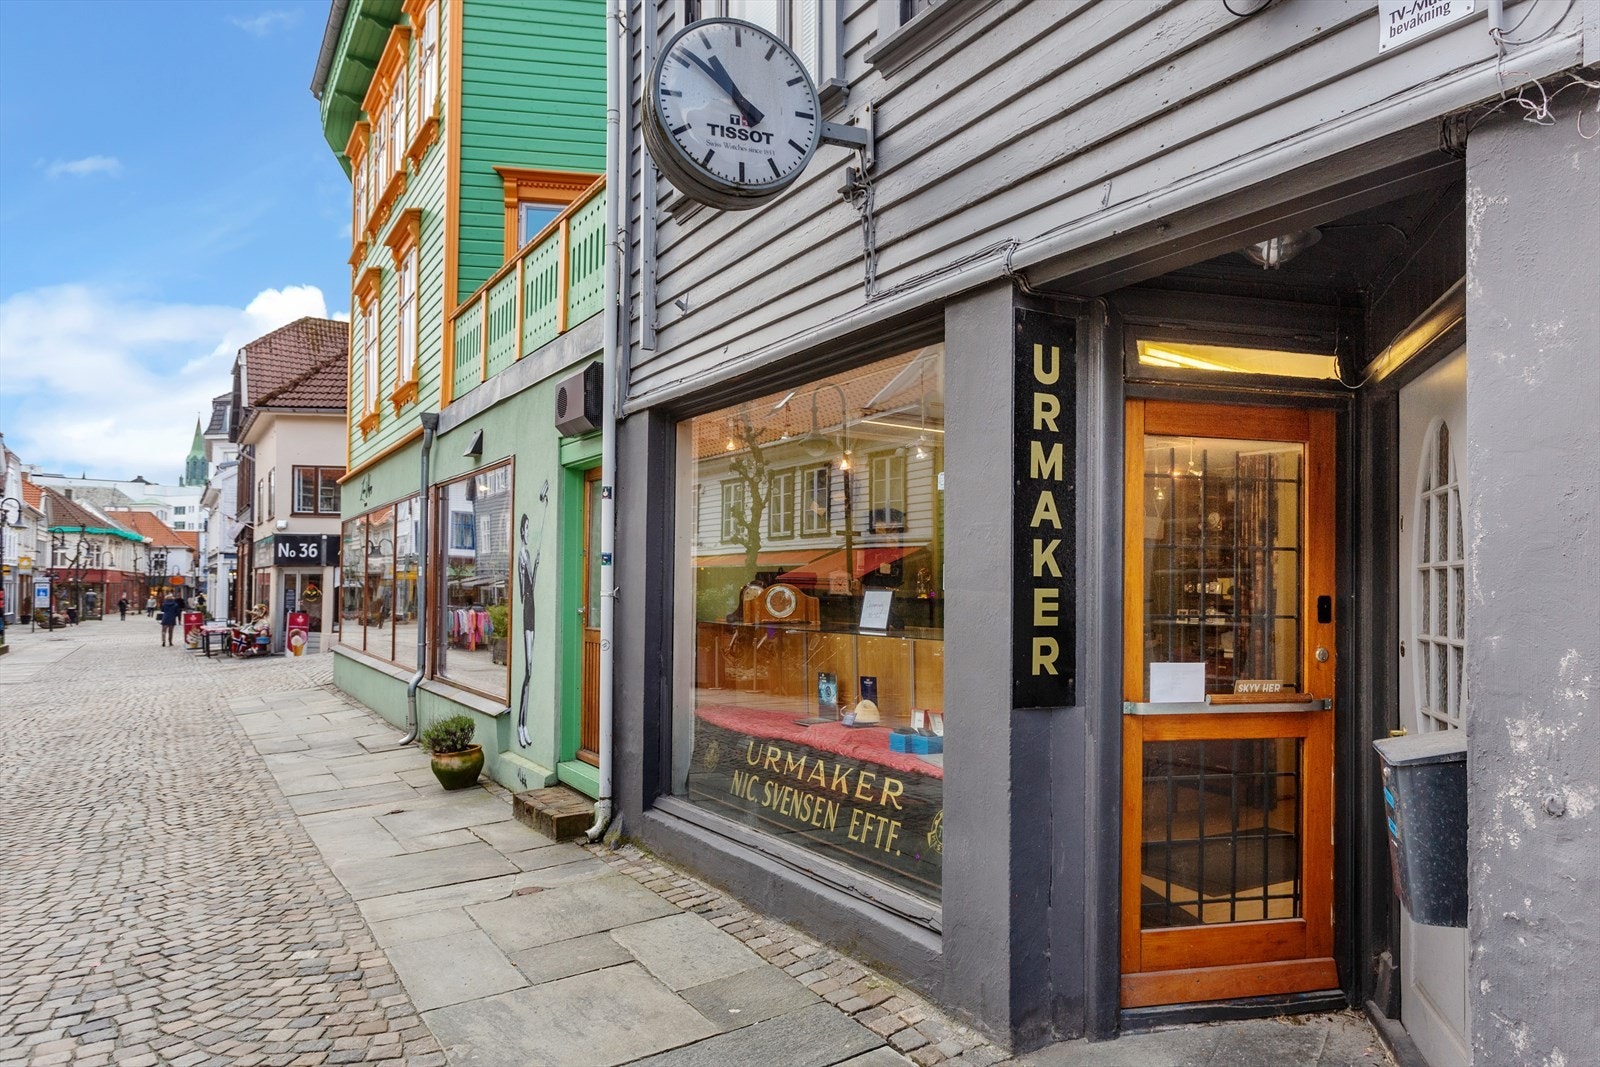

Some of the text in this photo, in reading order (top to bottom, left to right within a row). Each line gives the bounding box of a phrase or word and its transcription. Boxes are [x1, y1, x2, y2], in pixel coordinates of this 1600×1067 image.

[1389, 2, 1451, 38] bevakning
[706, 140, 722, 148] Swiss
[723, 141, 747, 152] Watches
[749, 146, 763, 154] since
[707, 123, 774, 145] TISSOT
[1030, 343, 1063, 676] URMAKER
[278, 543, 318, 558] No 36
[1238, 683, 1281, 693] SKYV HER
[746, 740, 904, 811] URMAKER
[730, 769, 902, 857] NIC. SVENSEN EFTF.
